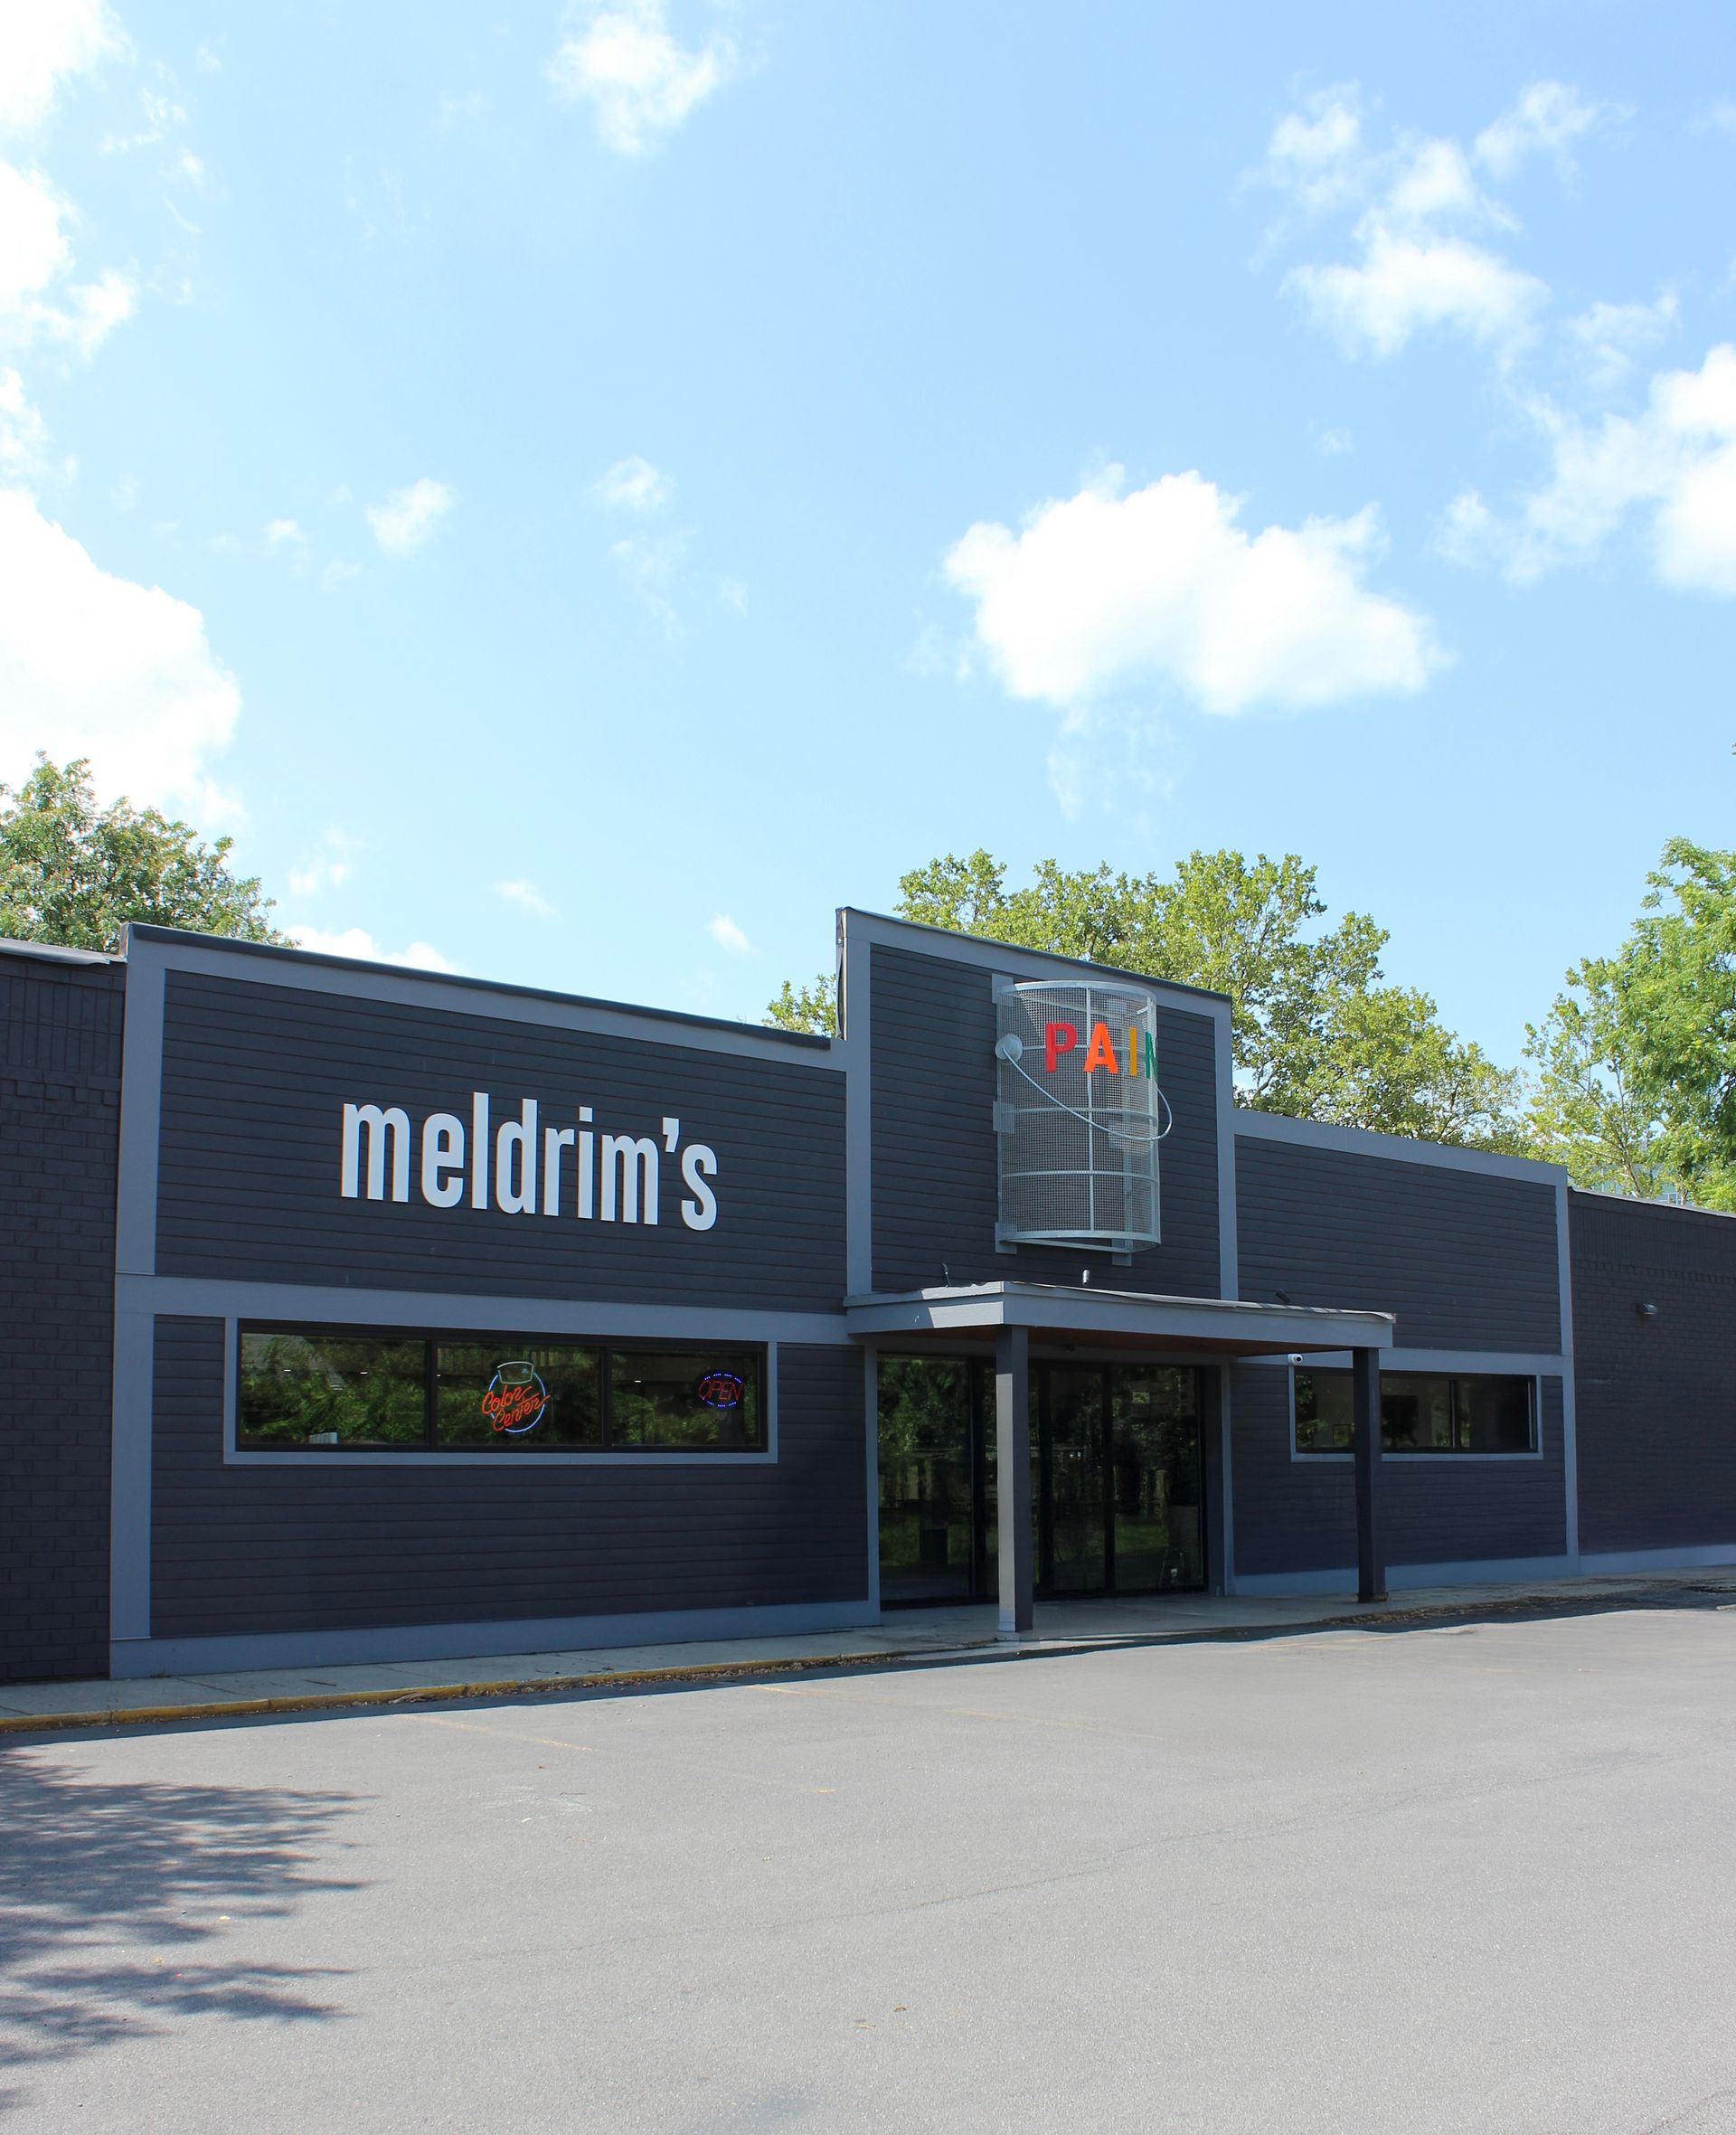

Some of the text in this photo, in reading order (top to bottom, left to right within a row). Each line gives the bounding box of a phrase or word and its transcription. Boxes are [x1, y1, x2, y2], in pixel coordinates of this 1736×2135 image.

[341, 1091, 717, 1231] meldrim's
[481, 1384, 533, 1415] Color
[698, 1380, 744, 1401] OPEN
[493, 1393, 551, 1431] Center
